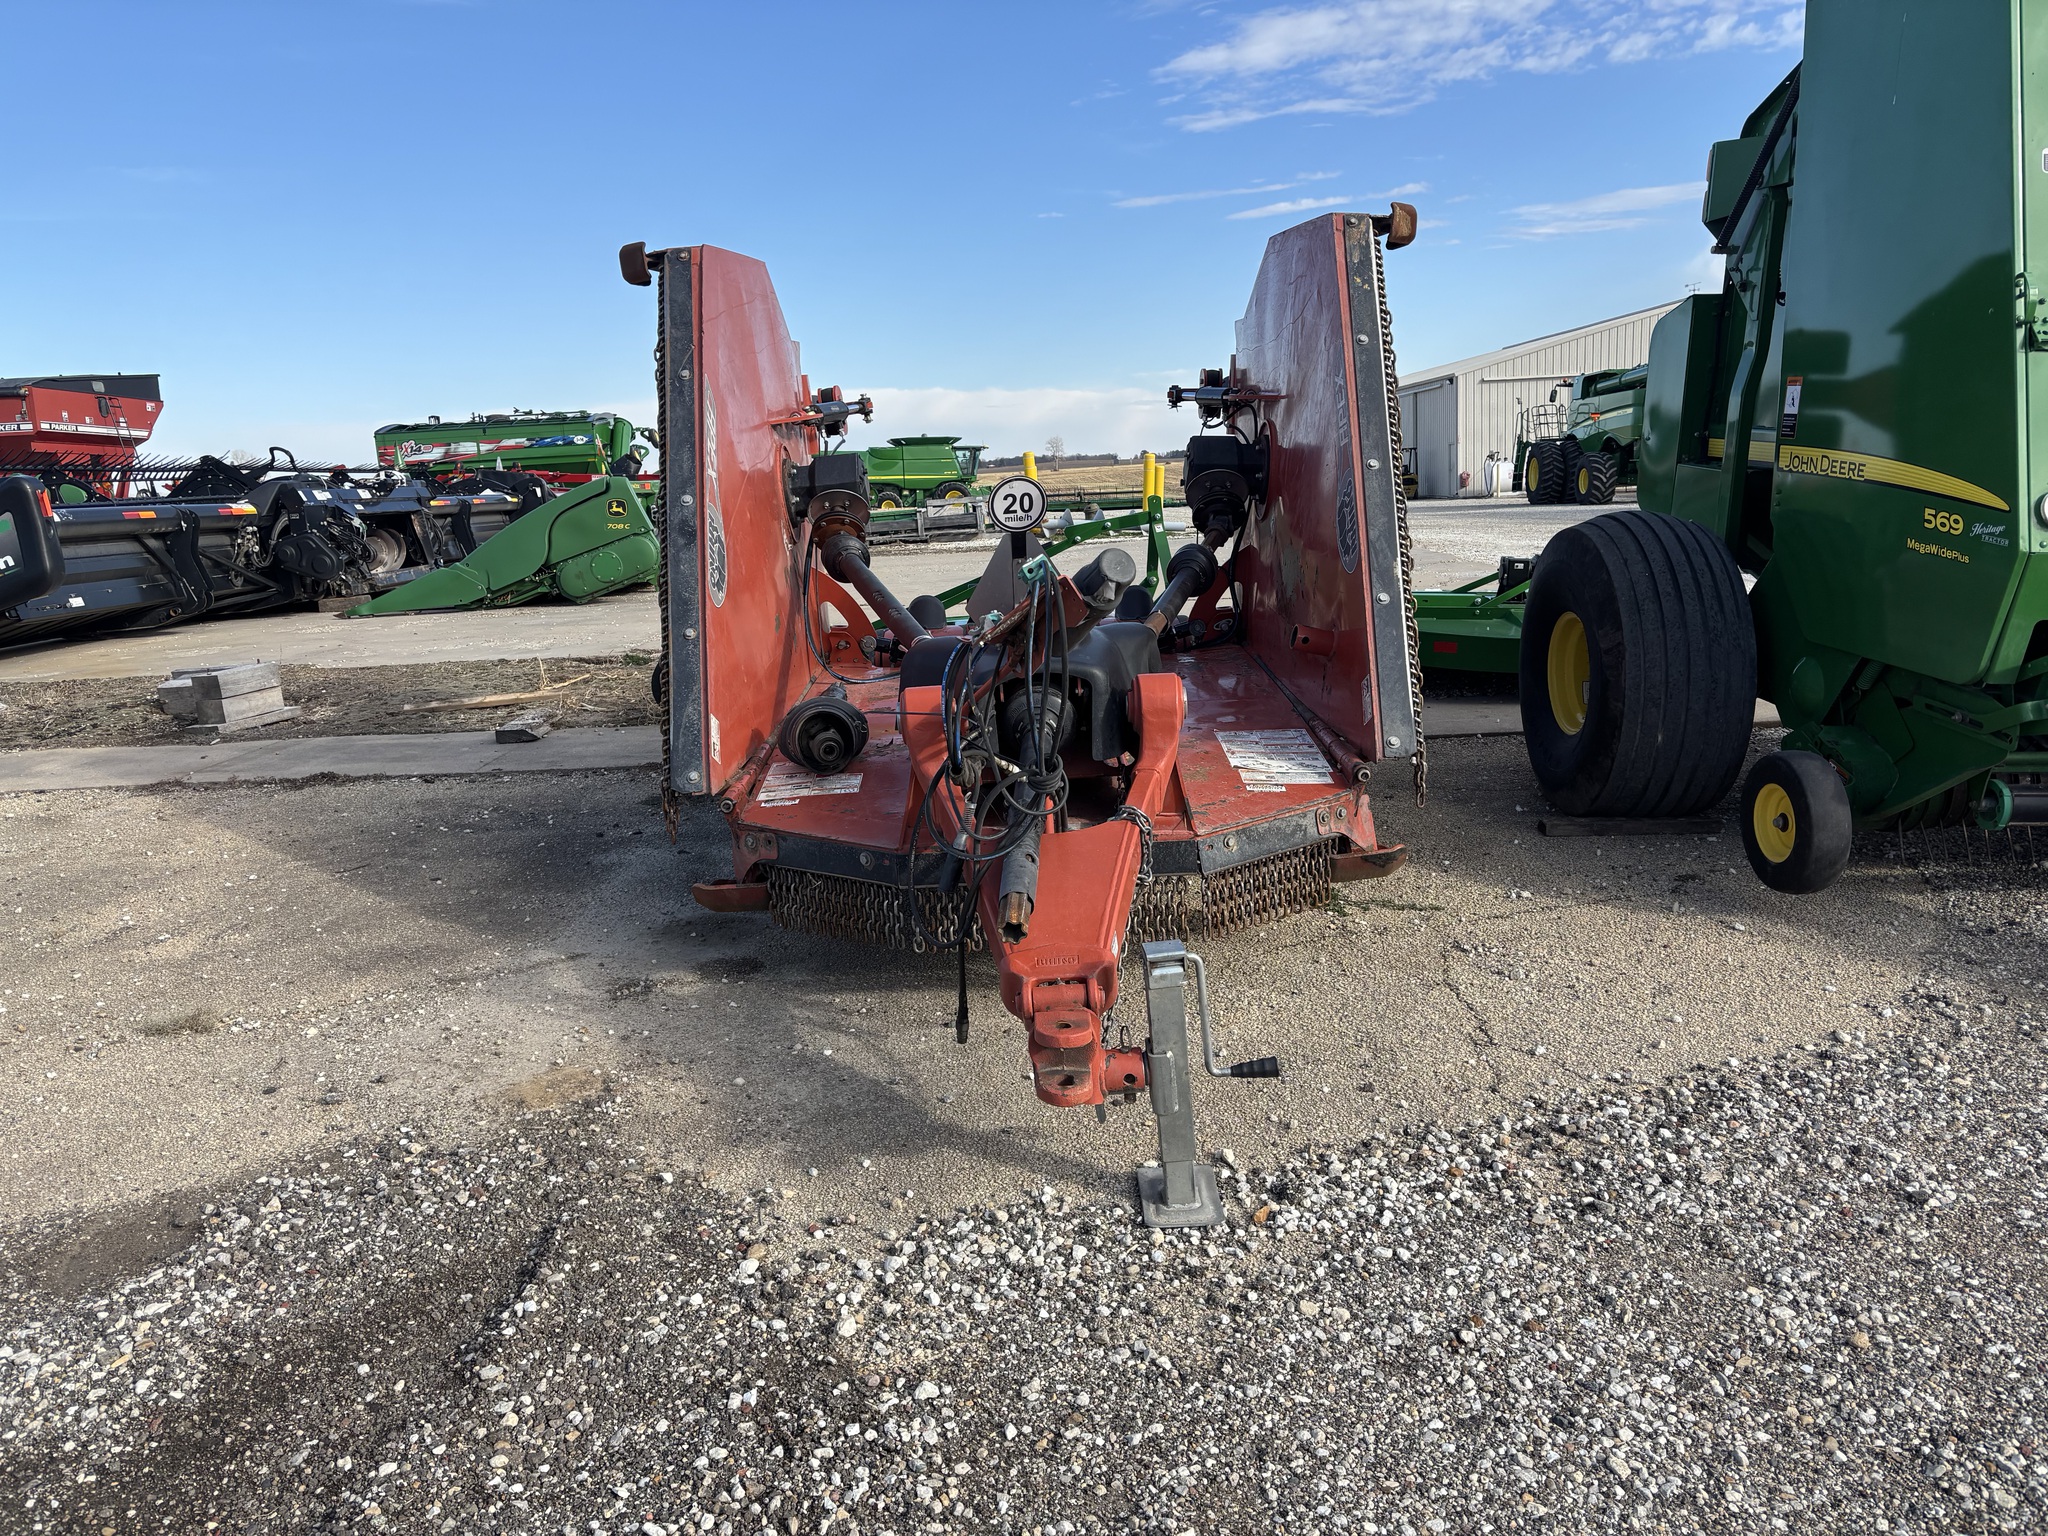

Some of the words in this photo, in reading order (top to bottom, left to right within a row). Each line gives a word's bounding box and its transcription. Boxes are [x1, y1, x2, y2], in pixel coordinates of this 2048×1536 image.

[51, 423, 76, 431] PARKER
[1785, 452, 1818, 471] JOHN
[1820, 455, 1866, 478] DEERE
[1003, 492, 1033, 514] 20
[1005, 514, 1032, 522] mile/h
[1924, 508, 1964, 535] 569
[1970, 522, 2006, 536] Heritage
[1981, 534, 2010, 547] TRACTOR
[1906, 537, 1970, 564] MegaWidePlus
